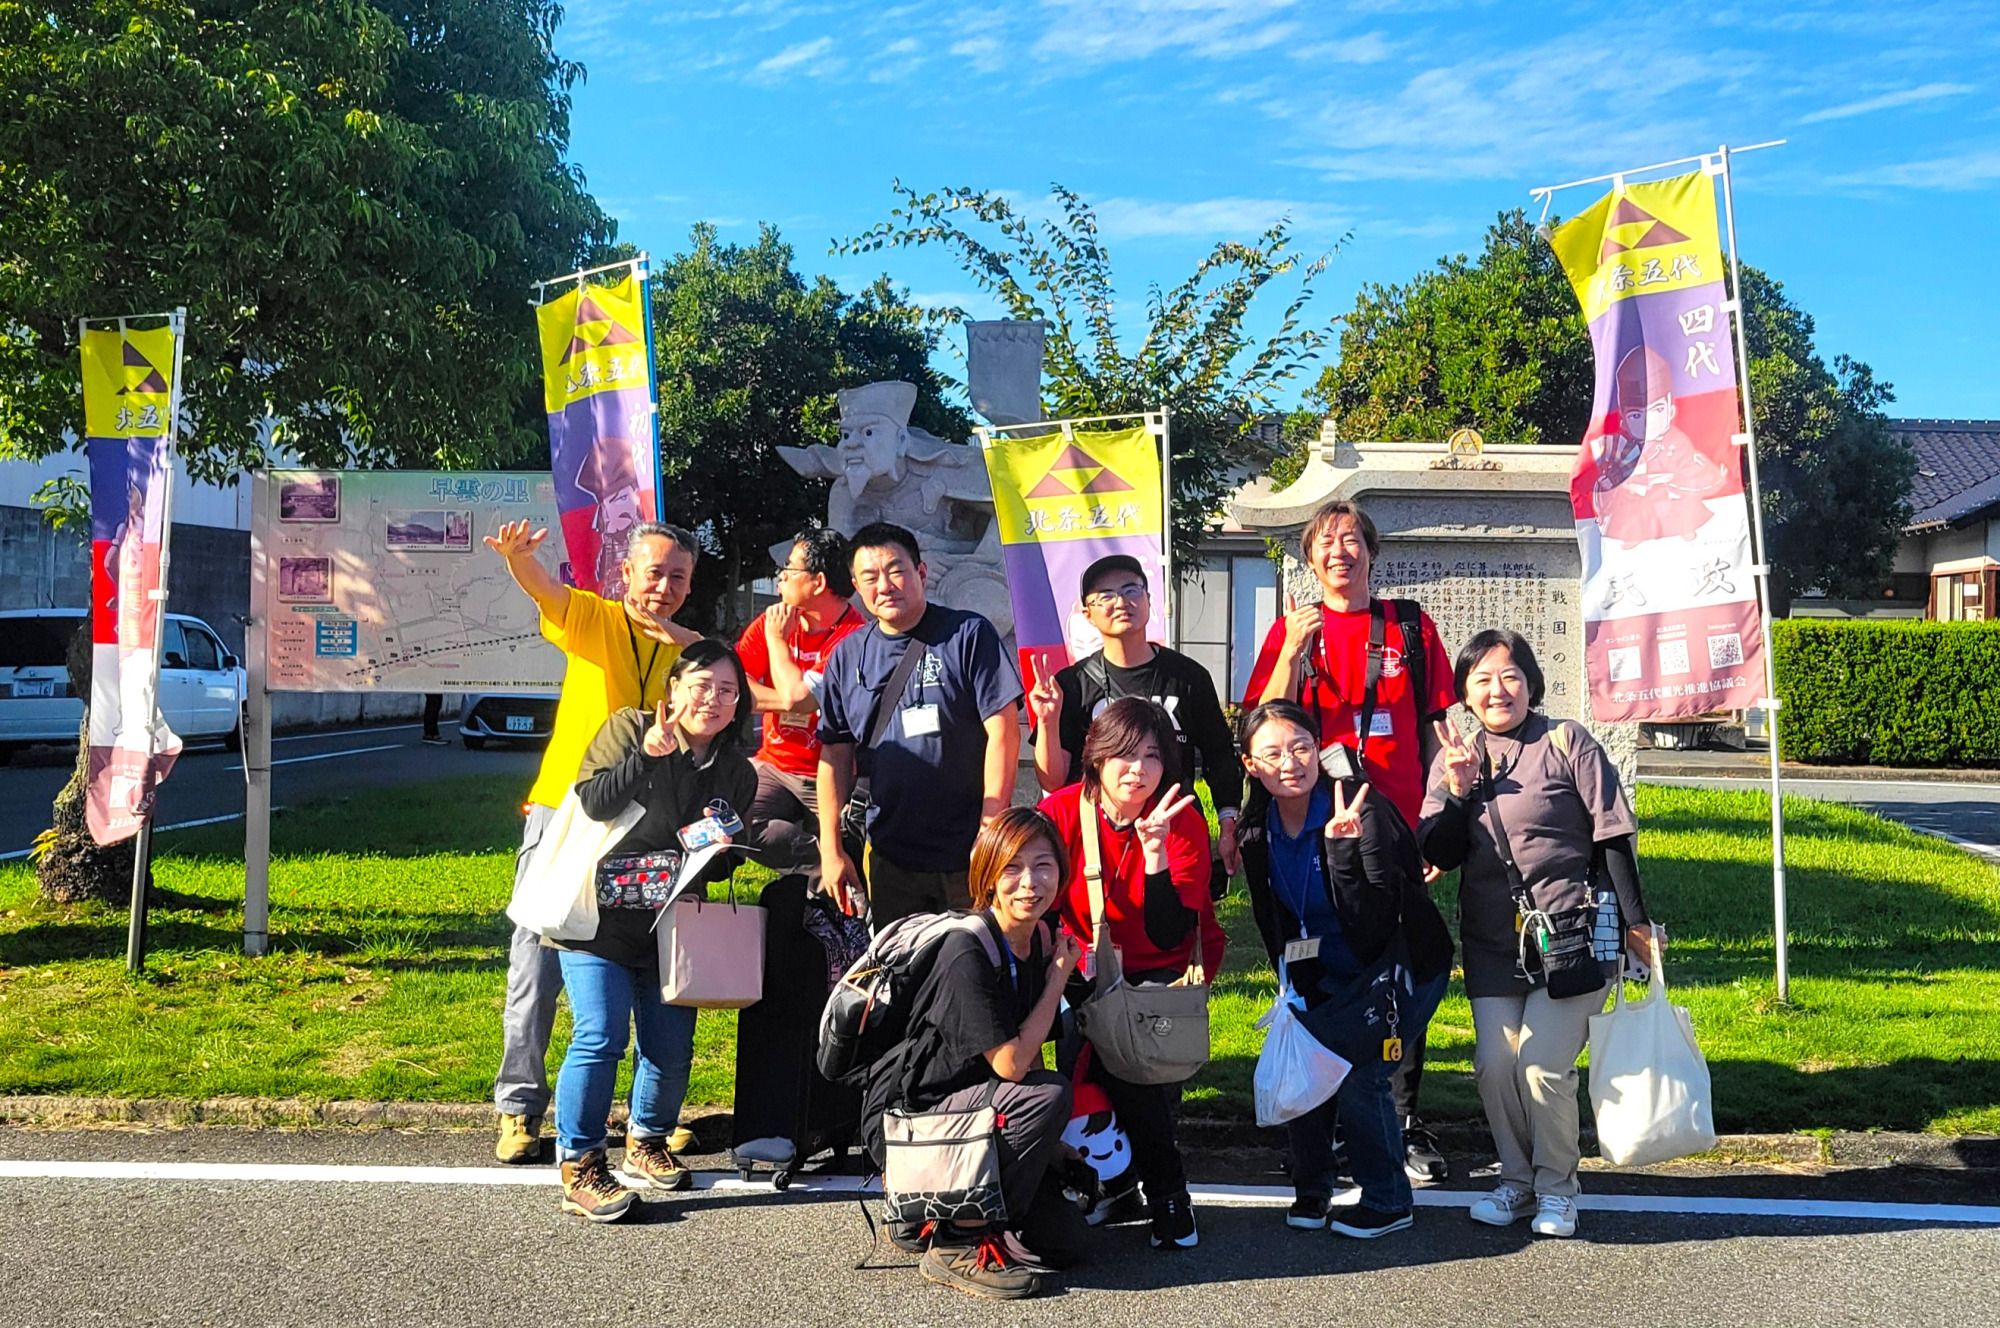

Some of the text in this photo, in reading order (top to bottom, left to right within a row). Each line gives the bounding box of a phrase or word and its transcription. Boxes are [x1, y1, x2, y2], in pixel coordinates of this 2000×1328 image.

[1678, 304, 1720, 379] 四代
[429, 477, 530, 503] 早雲の里
[1025, 503, 1141, 535] 北条五代
